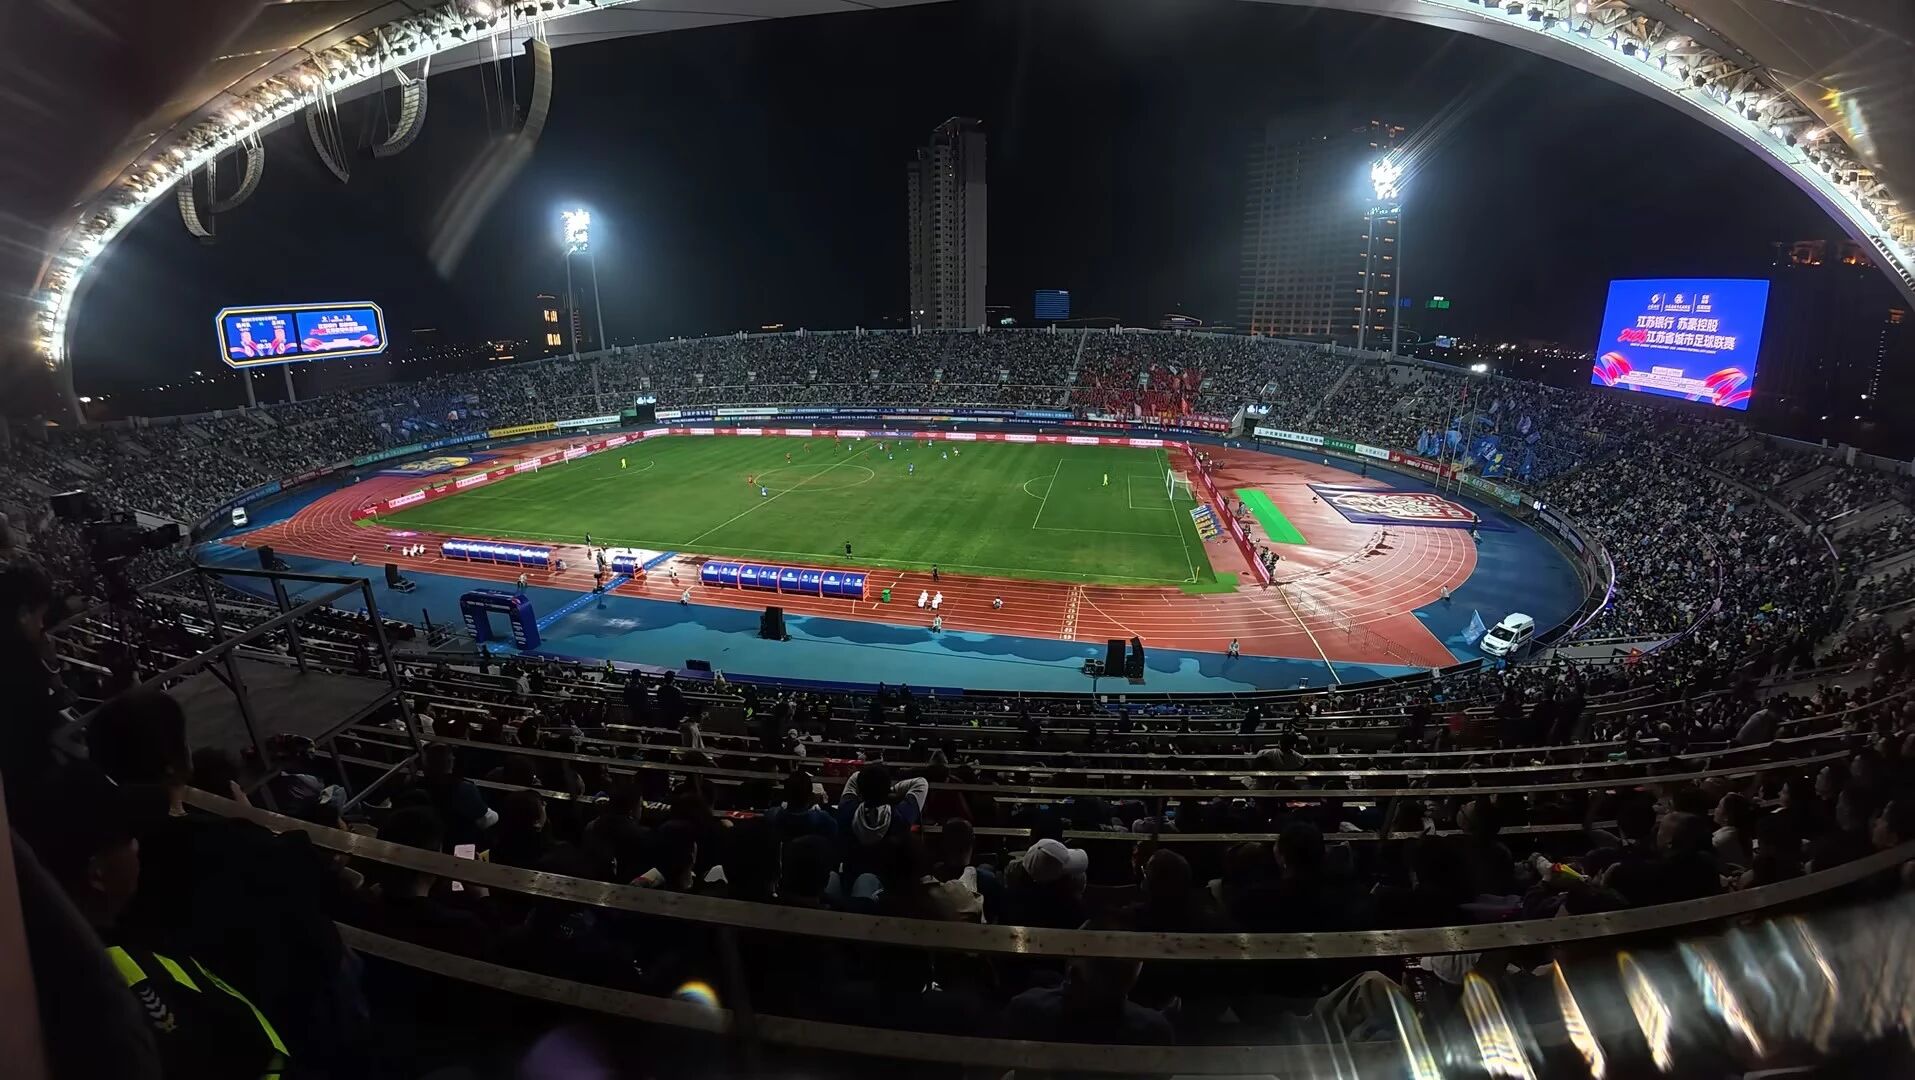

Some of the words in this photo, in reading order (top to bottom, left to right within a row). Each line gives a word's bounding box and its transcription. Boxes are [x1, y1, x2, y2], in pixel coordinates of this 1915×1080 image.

[1636, 316, 1674, 329] 江苏银行
[1677, 317, 1718, 332] 苏豪控股
